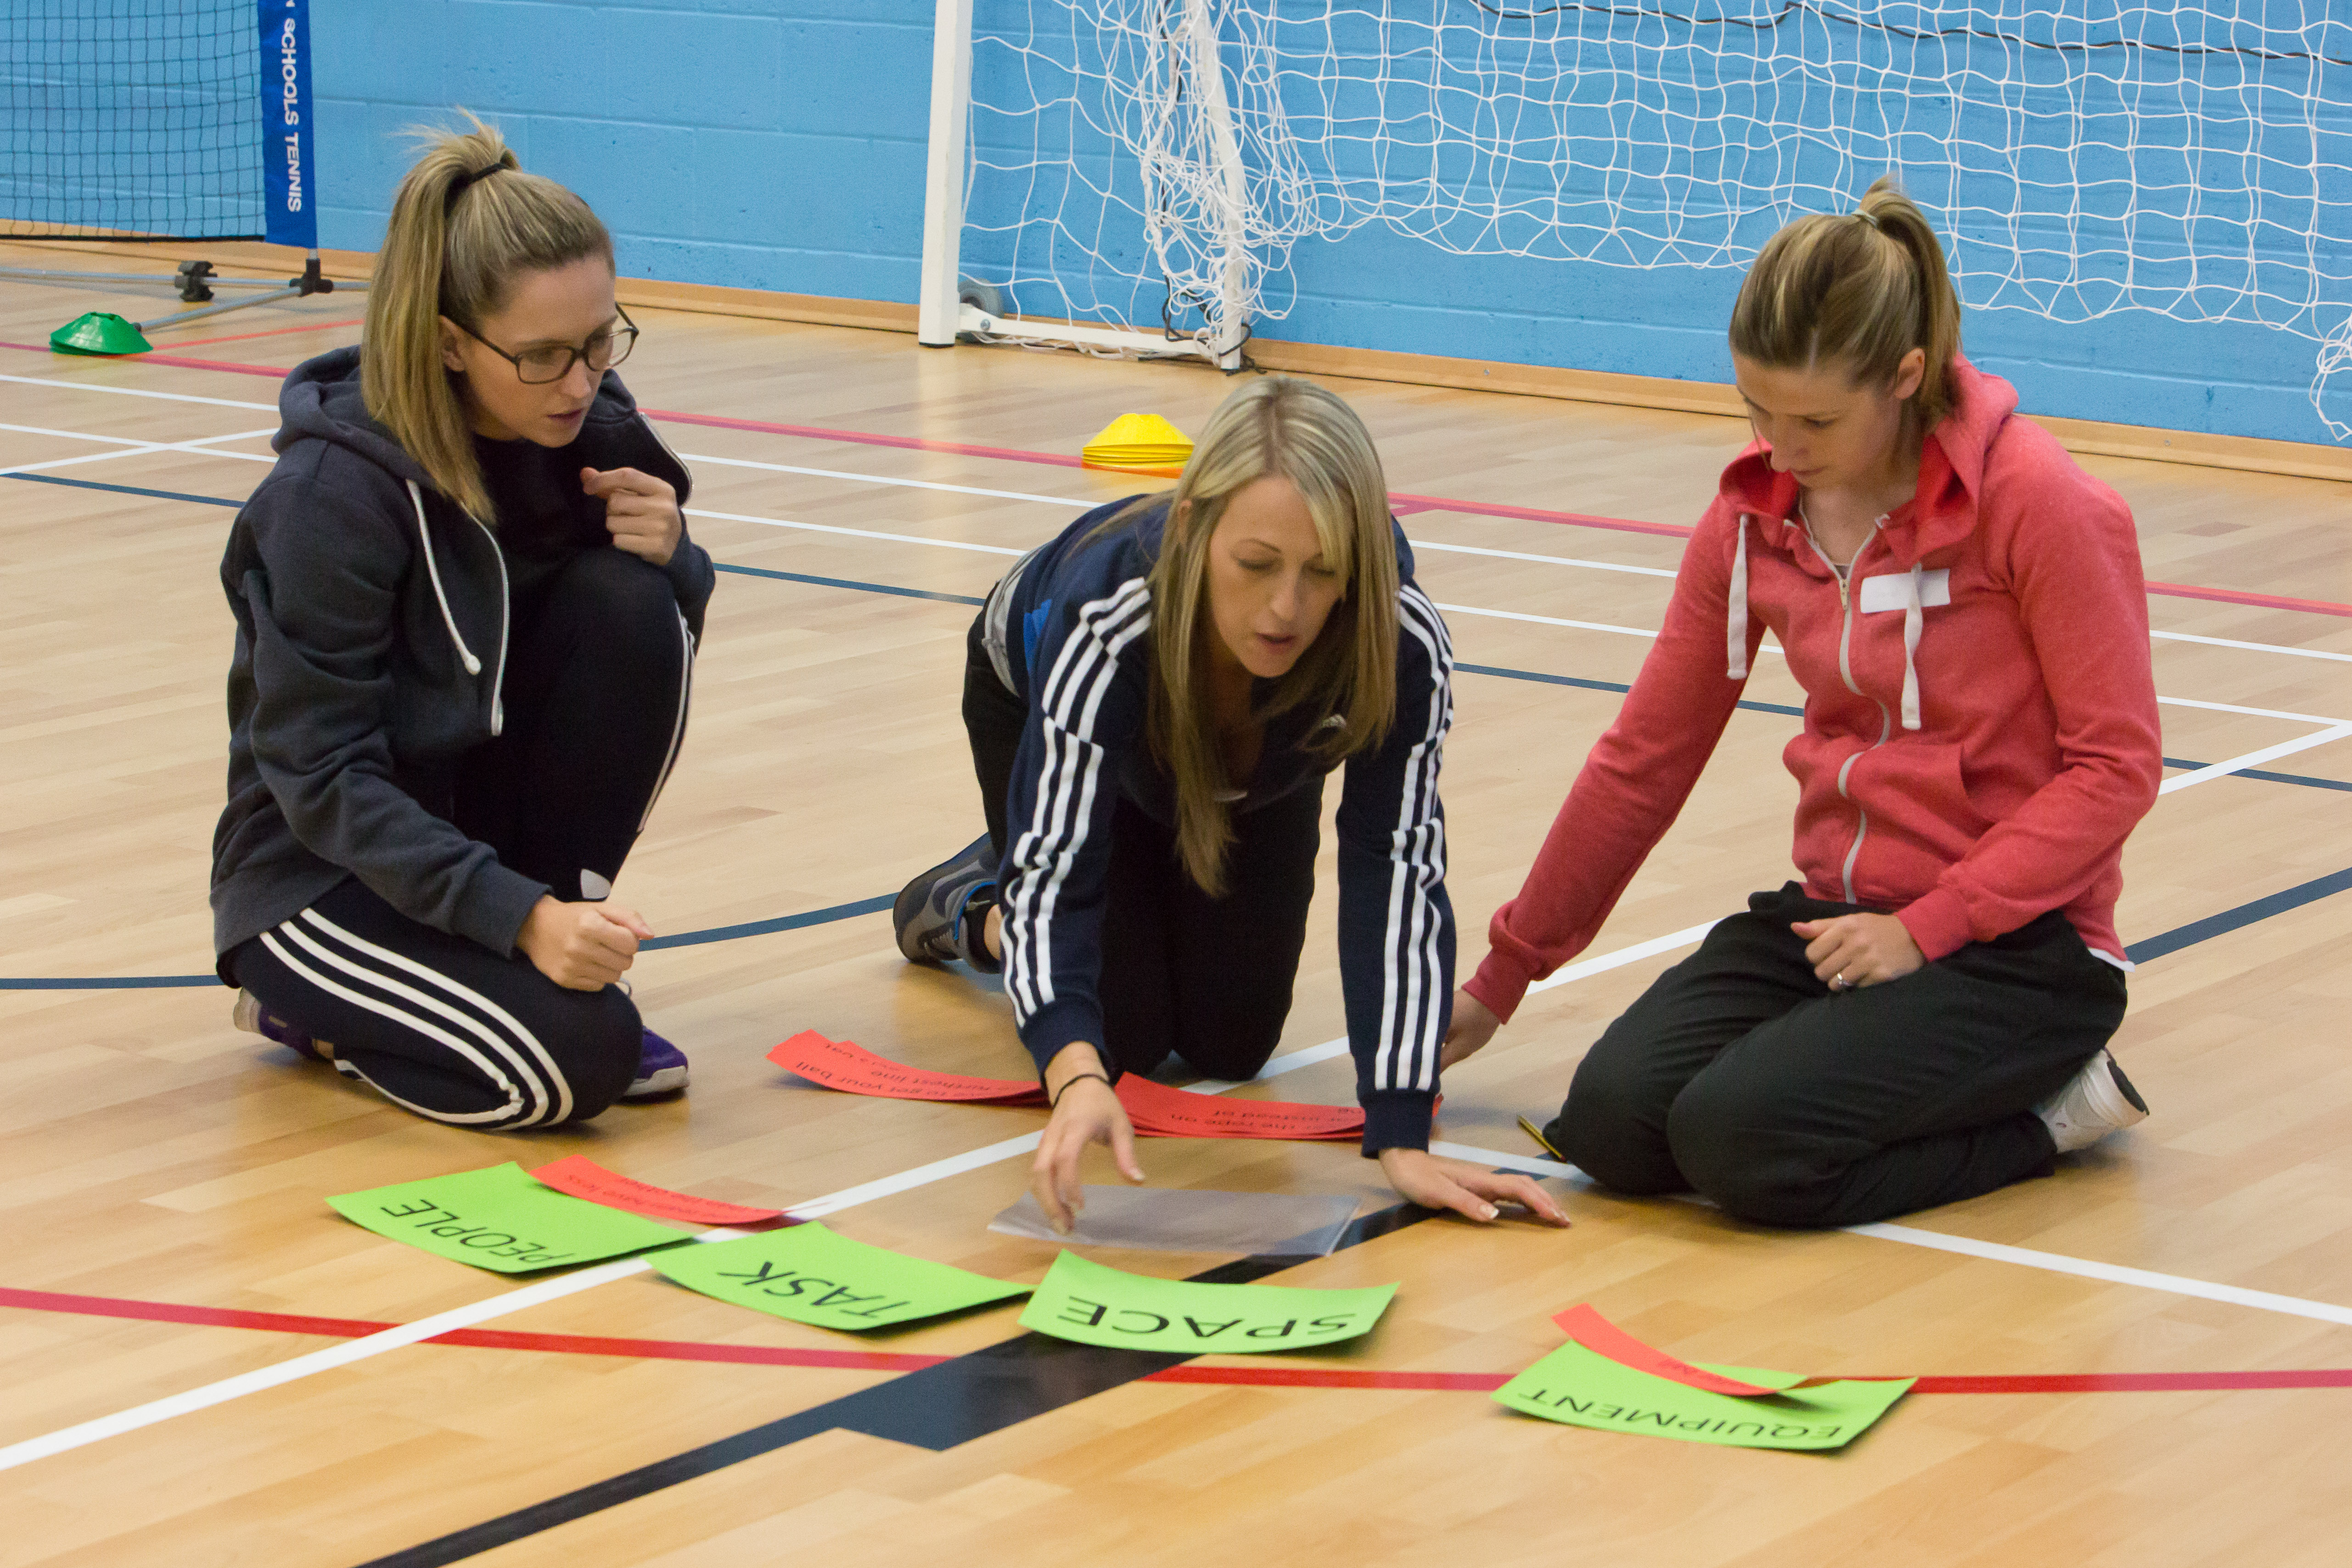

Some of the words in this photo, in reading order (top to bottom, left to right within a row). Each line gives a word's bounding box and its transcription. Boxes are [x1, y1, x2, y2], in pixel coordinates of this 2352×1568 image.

[281, 17, 299, 125] SCHOOLS
[285, 132, 302, 213] TENNIS
[795, 1061, 833, 1079] ball
[838, 1077, 882, 1090] your
[871, 1071, 906, 1082] line
[380, 1199, 573, 1265] PEOPLE
[717, 1260, 912, 1319] TASK
[1057, 1294, 1356, 1338] SPACE
[1518, 1388, 1841, 1440] EQUIPMENT
